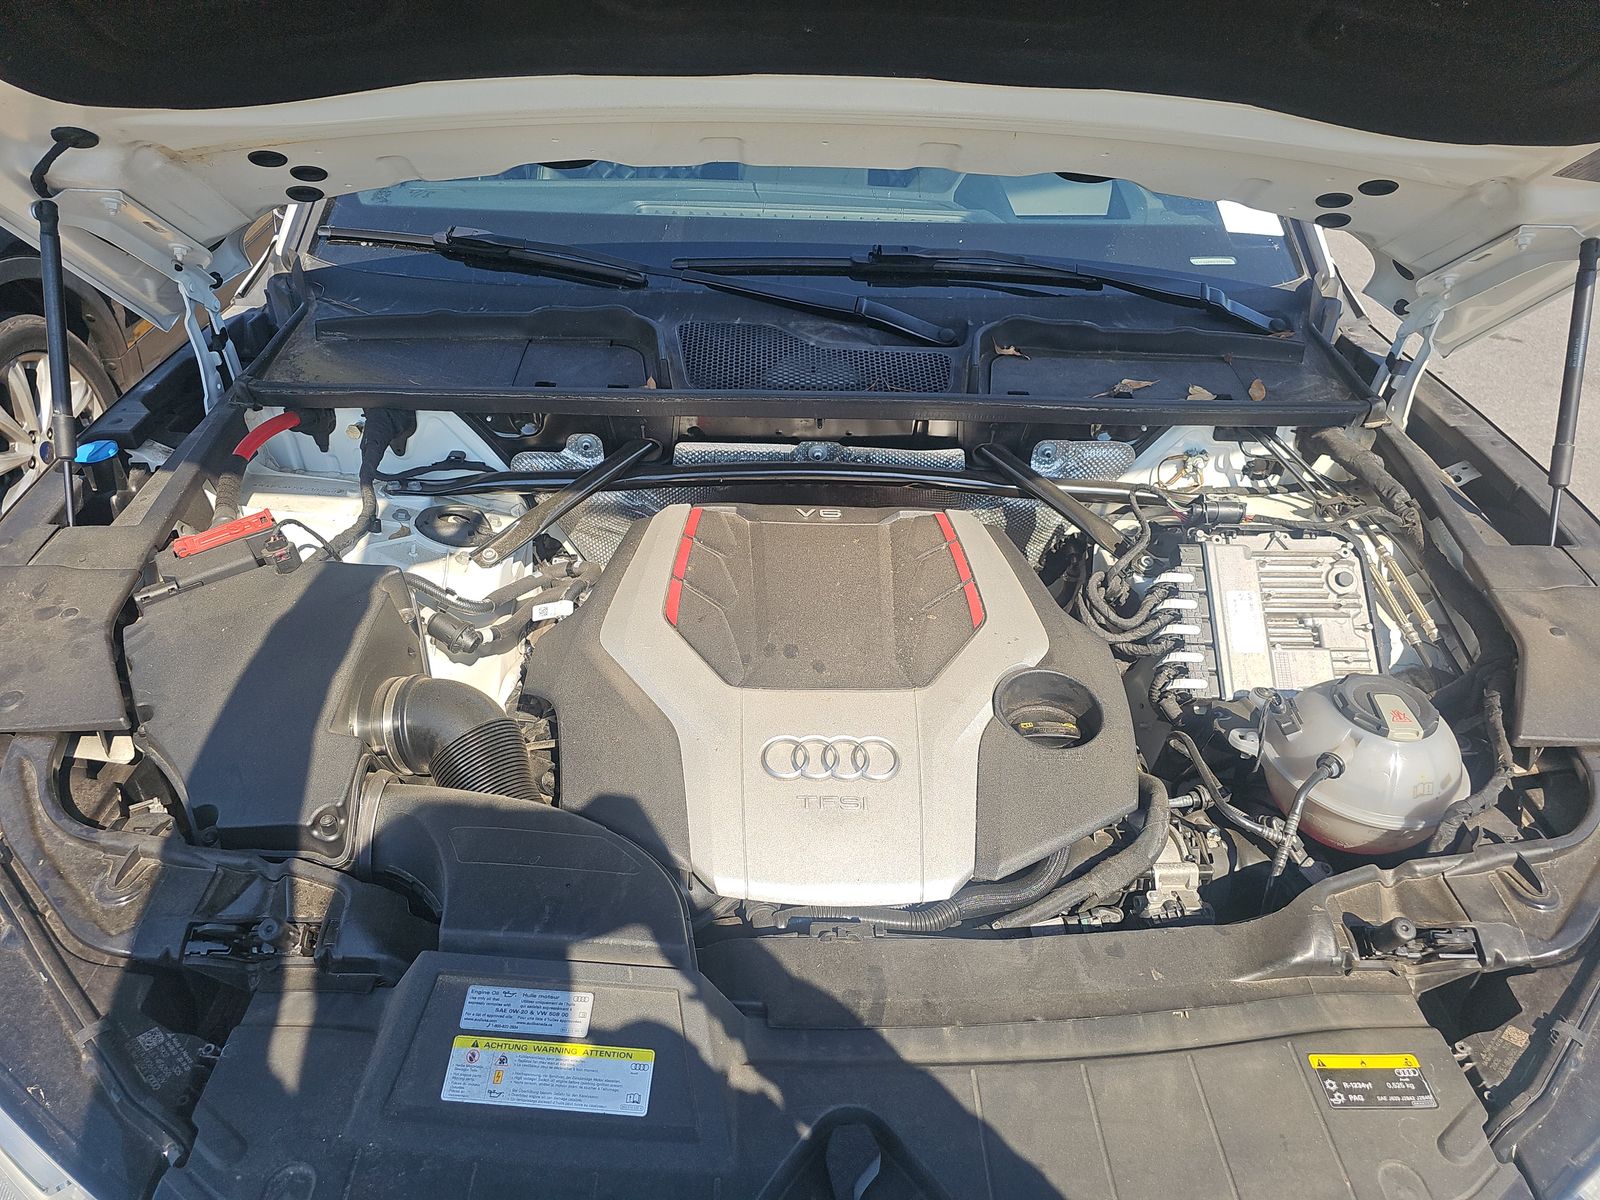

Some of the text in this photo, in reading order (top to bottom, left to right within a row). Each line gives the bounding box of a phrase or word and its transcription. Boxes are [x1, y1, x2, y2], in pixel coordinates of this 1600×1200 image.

[795, 508, 842, 518] V6
[796, 795, 868, 811] TFSI
[484, 1042, 528, 1051] ACHTUNG
[533, 1045, 578, 1055] WARNING
[582, 1049, 633, 1059] ATTENTION
[1343, 1081, 1373, 1090] R-1234yf
[1405, 1082, 1416, 1090] kg
